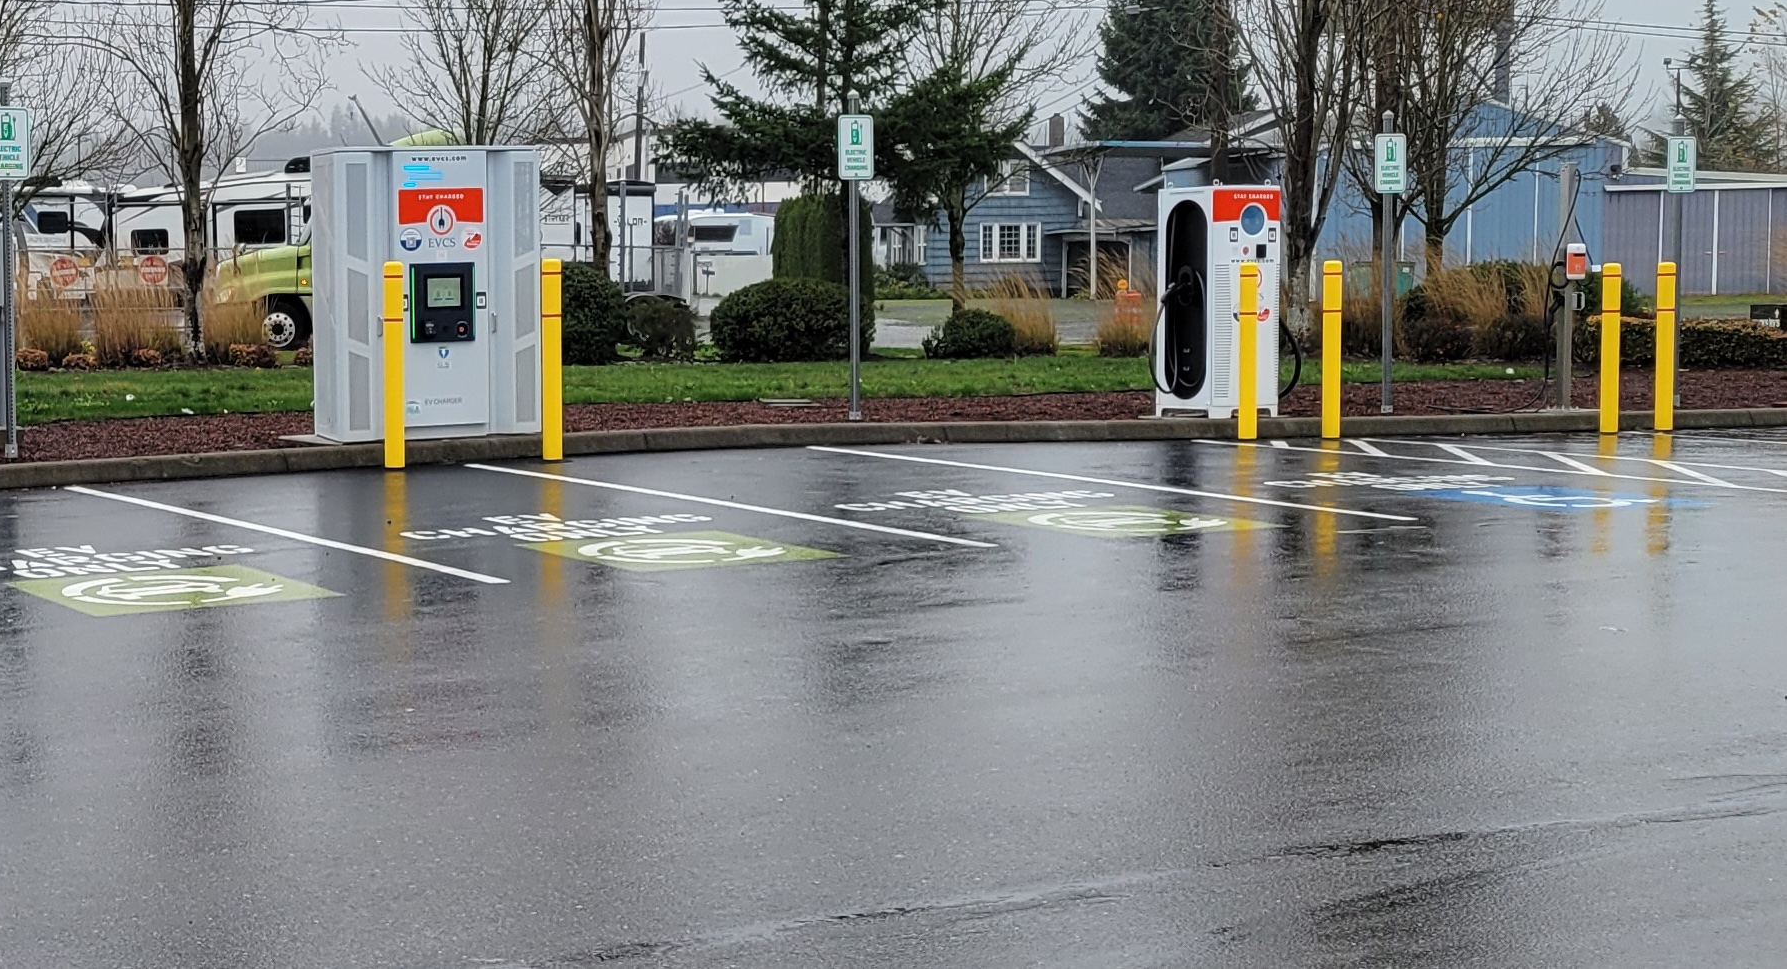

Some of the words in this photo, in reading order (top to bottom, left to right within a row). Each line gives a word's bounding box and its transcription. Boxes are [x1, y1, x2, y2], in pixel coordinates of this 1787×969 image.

[428, 237, 456, 248] EVCS
[433, 397, 462, 405] CHARGER
[15, 544, 98, 559] EV
[11, 559, 182, 579] ONLY
